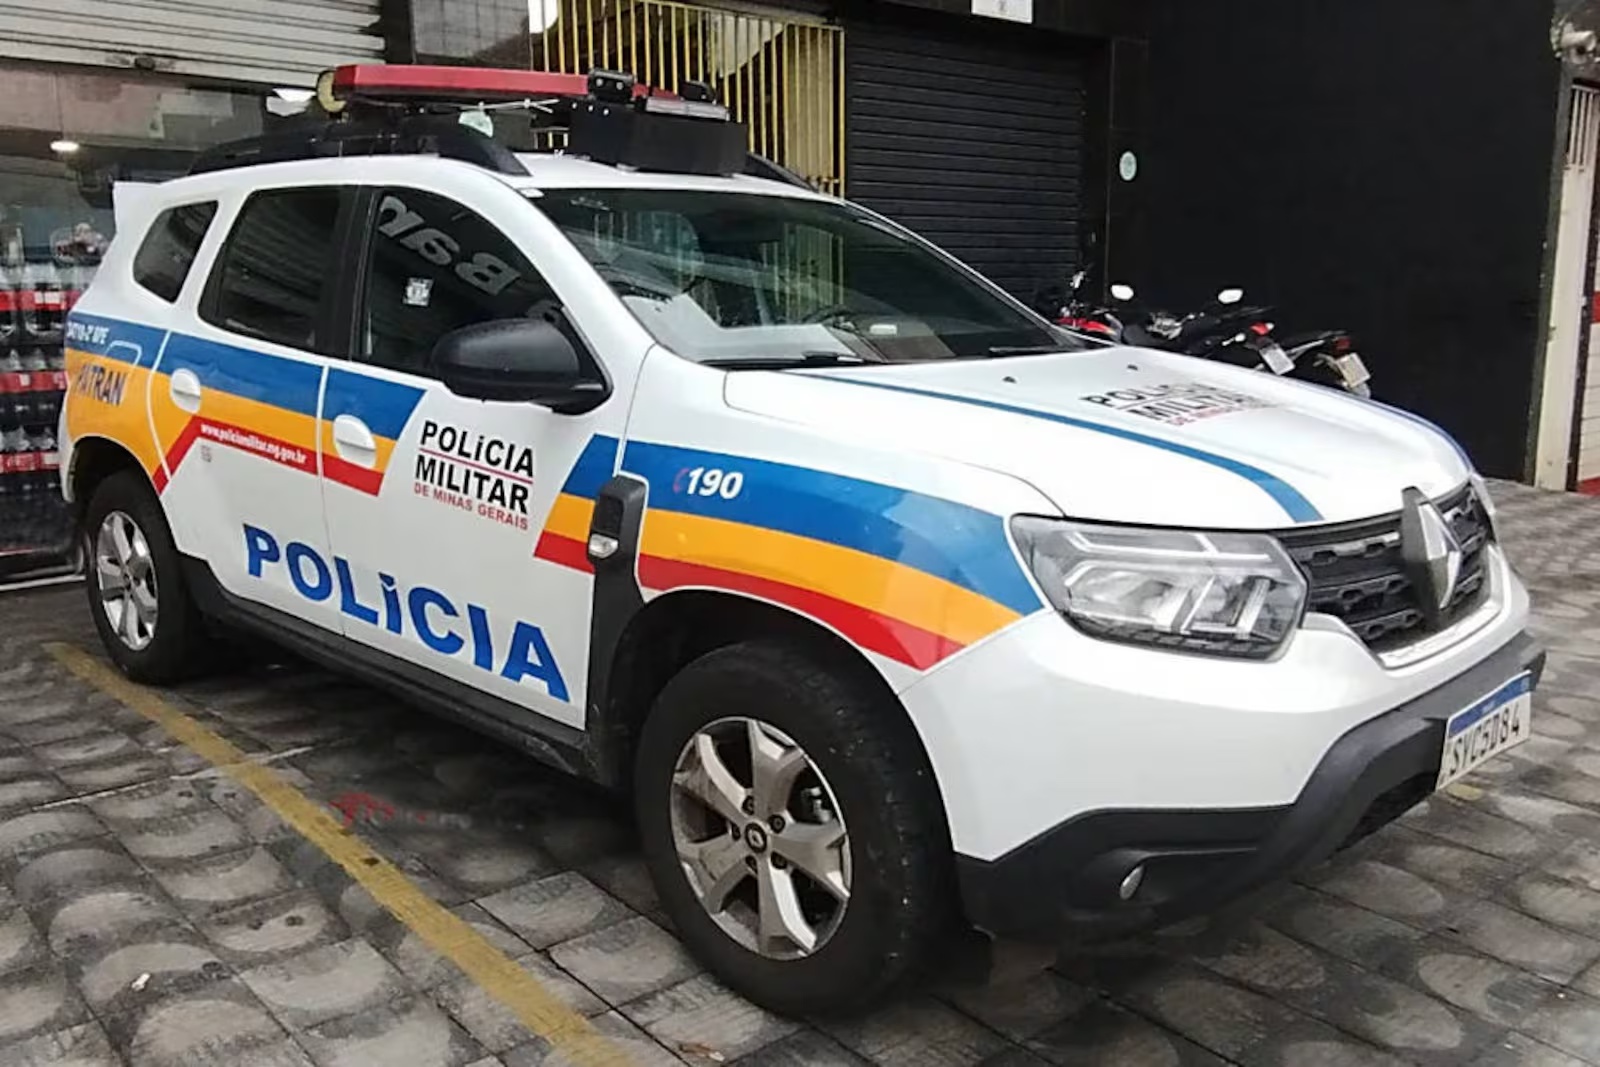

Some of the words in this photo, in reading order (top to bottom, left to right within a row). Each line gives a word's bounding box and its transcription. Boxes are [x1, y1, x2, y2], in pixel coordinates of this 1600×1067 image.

[414, 482, 430, 497] DE
[433, 488, 473, 511] MINAS
[477, 503, 529, 530] GERAIS
[416, 454, 529, 514] MILITAR
[687, 466, 744, 500] 190
